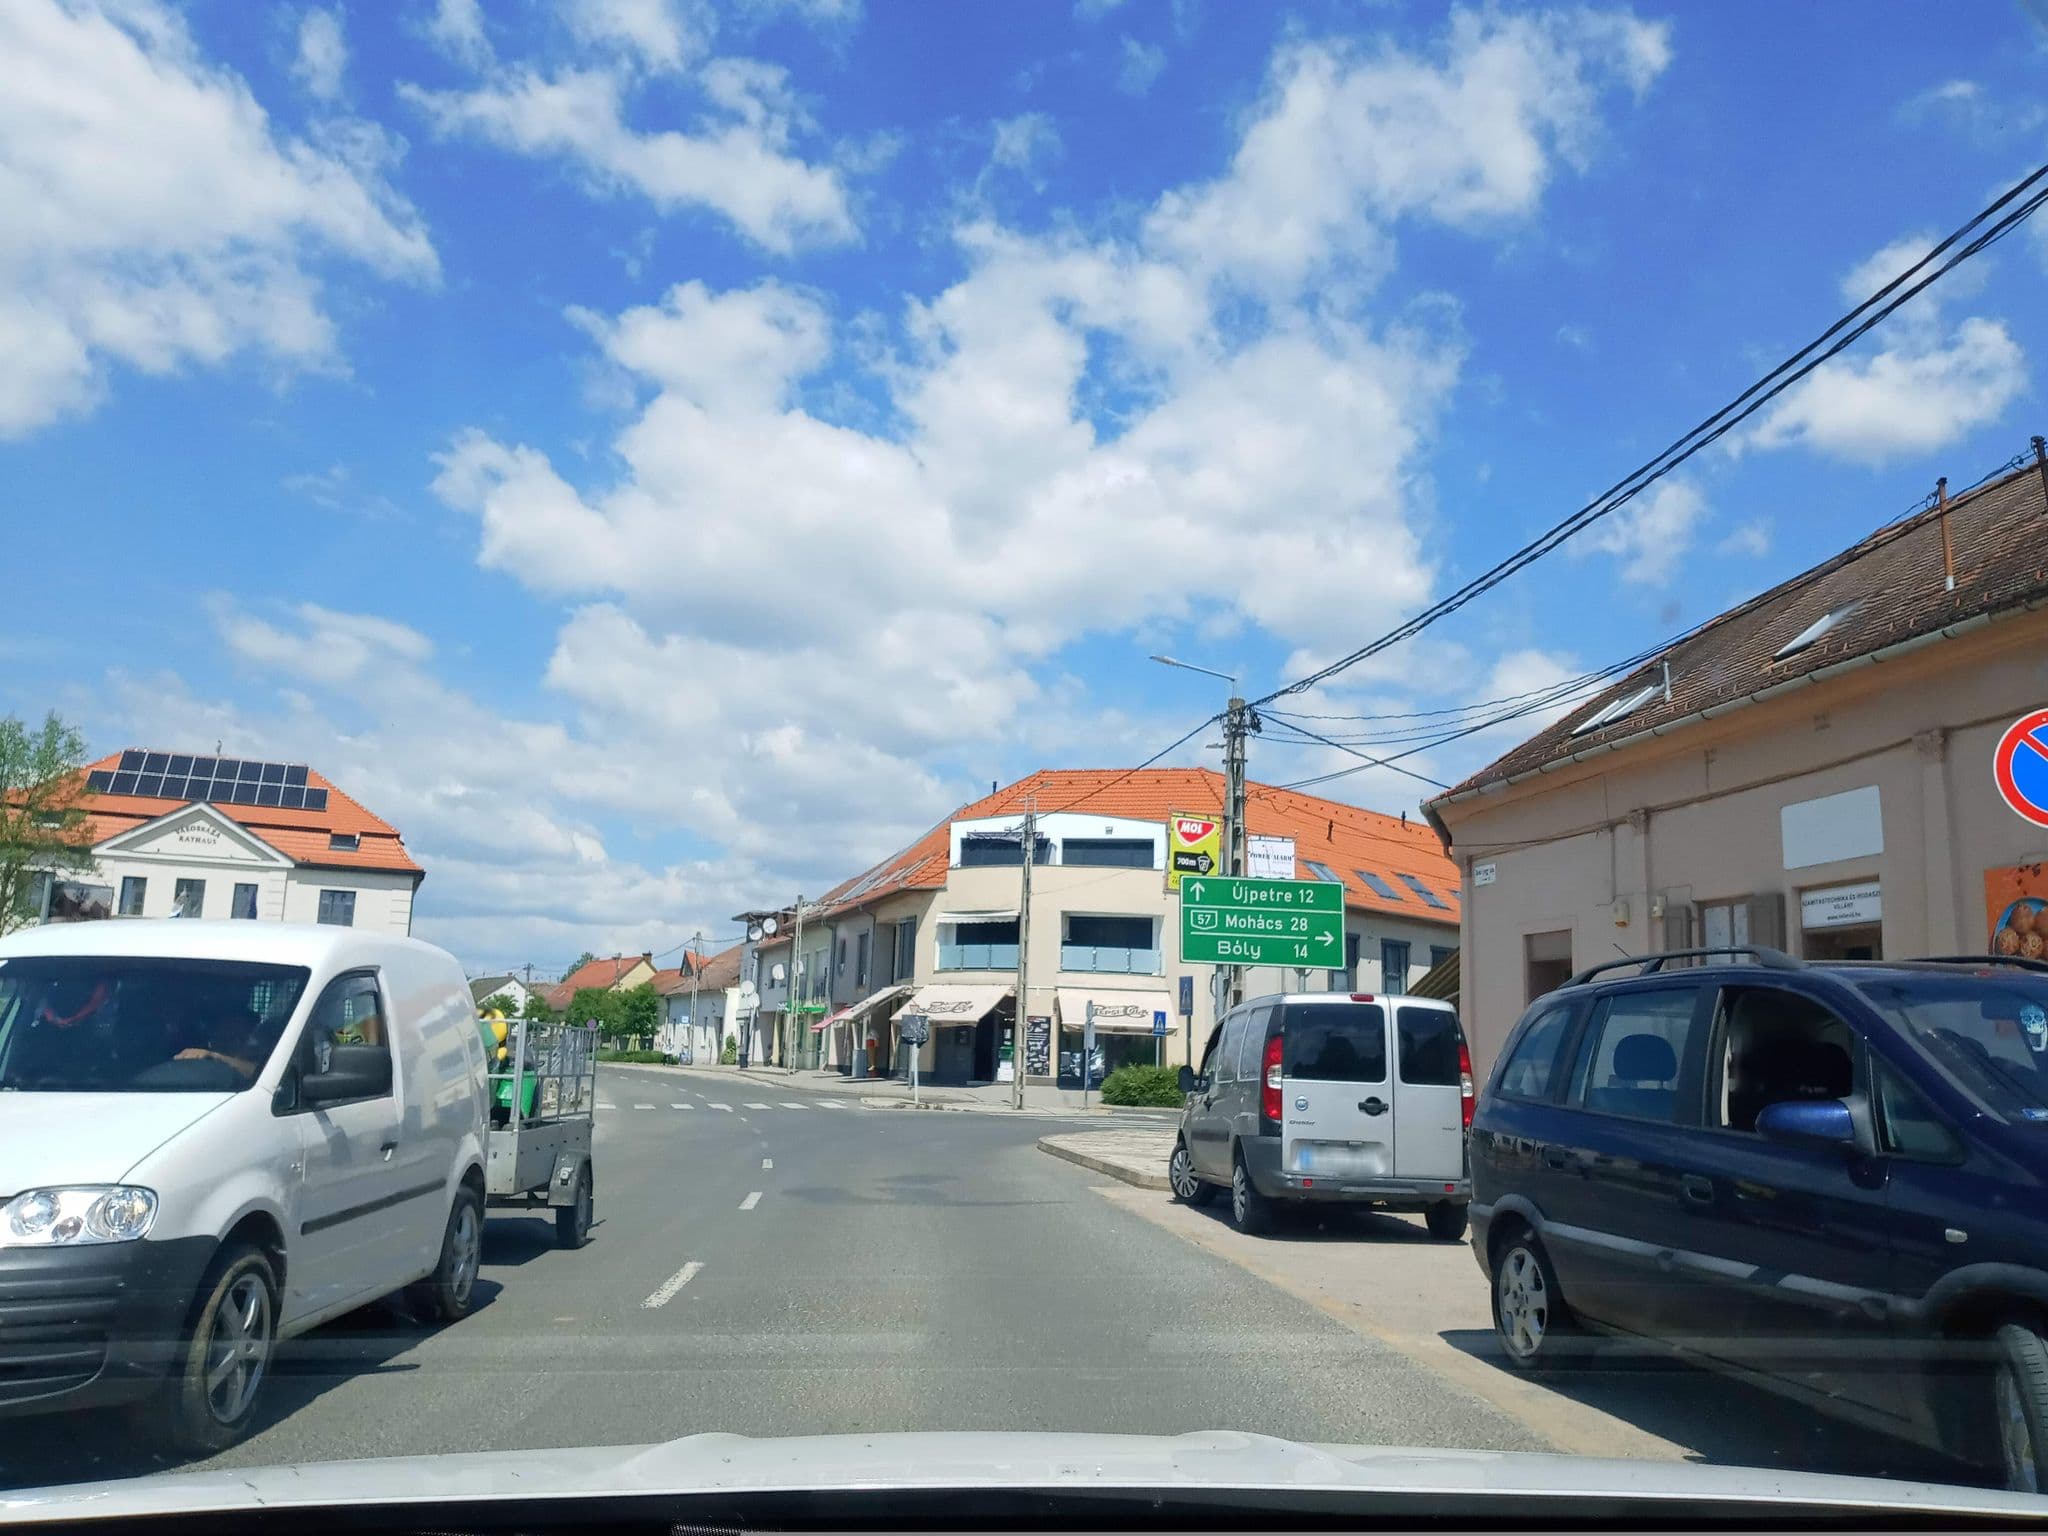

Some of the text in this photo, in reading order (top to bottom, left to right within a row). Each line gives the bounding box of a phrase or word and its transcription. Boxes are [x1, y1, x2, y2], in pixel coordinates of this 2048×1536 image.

[1181, 822, 1203, 834] MOL
[1232, 881, 1314, 904] Újpetre 12
[1197, 914, 1308, 931] 57 Mohács 28
[1217, 939, 1308, 960] Bóly 14
